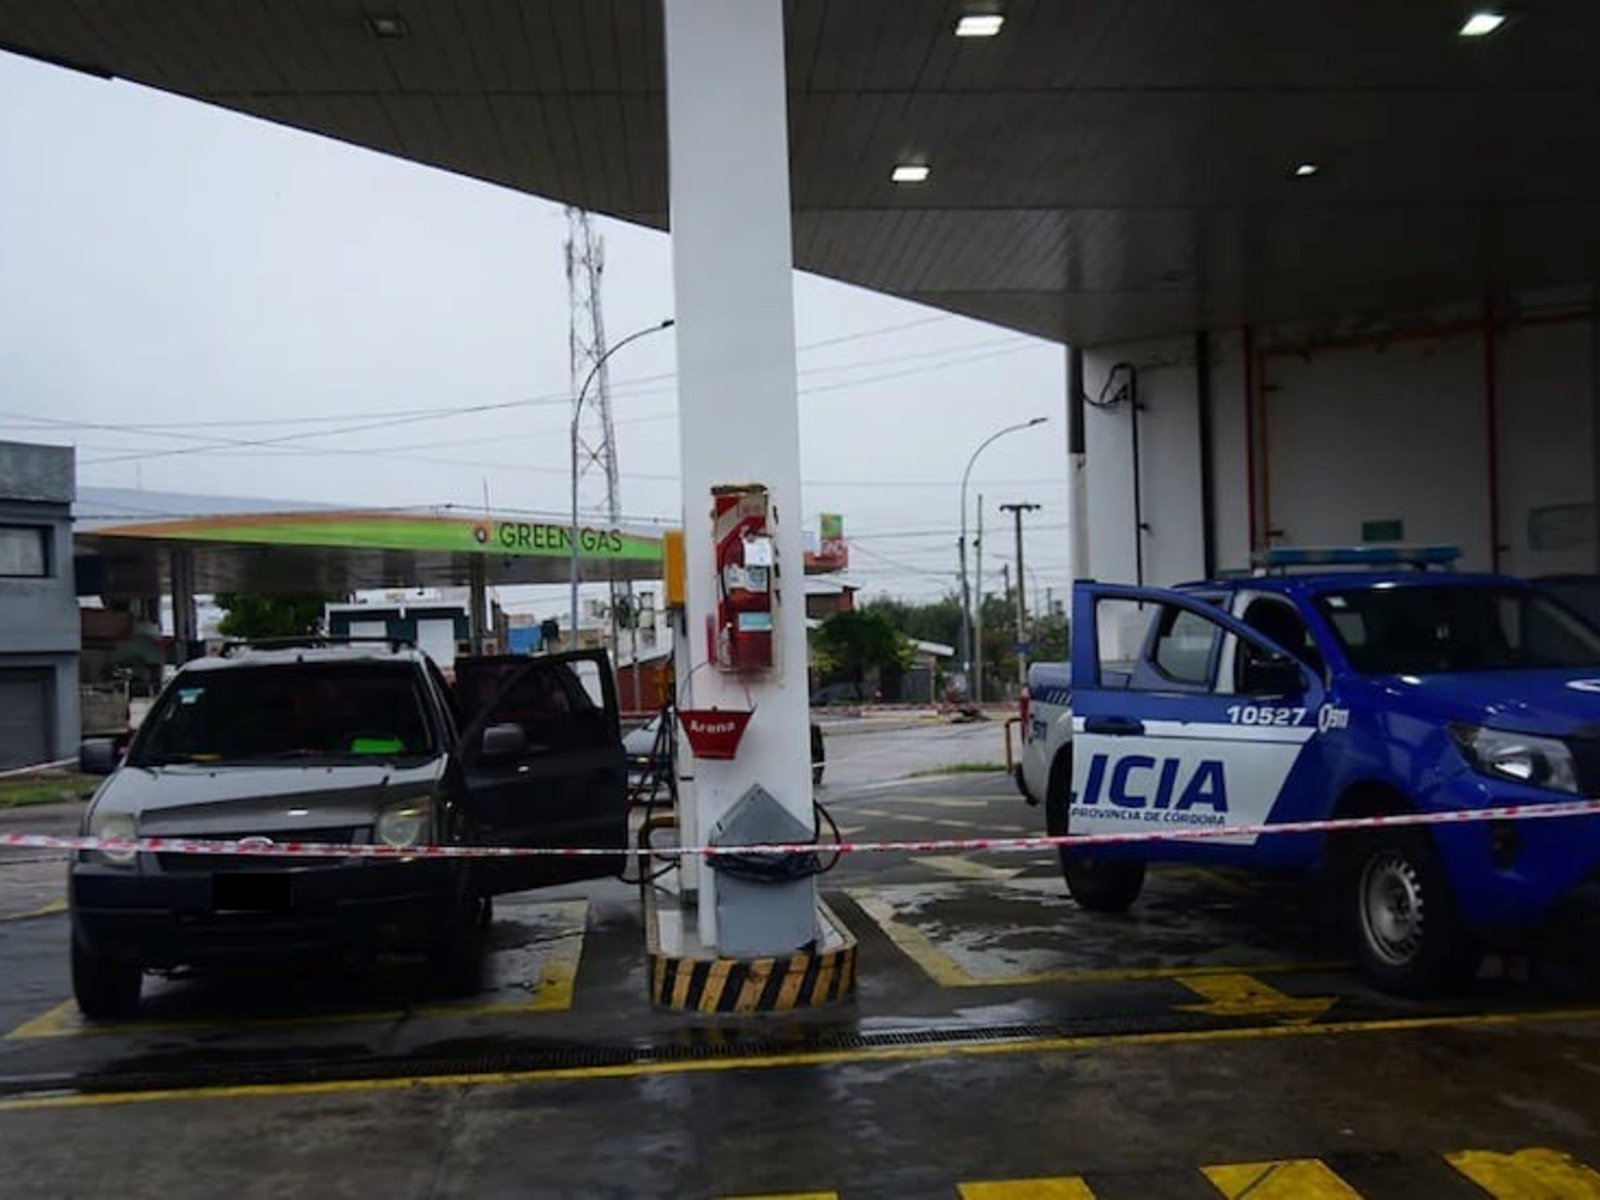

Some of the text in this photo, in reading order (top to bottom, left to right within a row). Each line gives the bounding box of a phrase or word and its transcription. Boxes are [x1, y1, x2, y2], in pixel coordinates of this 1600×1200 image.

[499, 522, 622, 552] GREEN GAS
[1226, 705, 1308, 726] 10527
[1069, 754, 1229, 813] ICIA
[1072, 806, 1141, 821] PROVINCIA
[1143, 811, 1160, 822] DE
